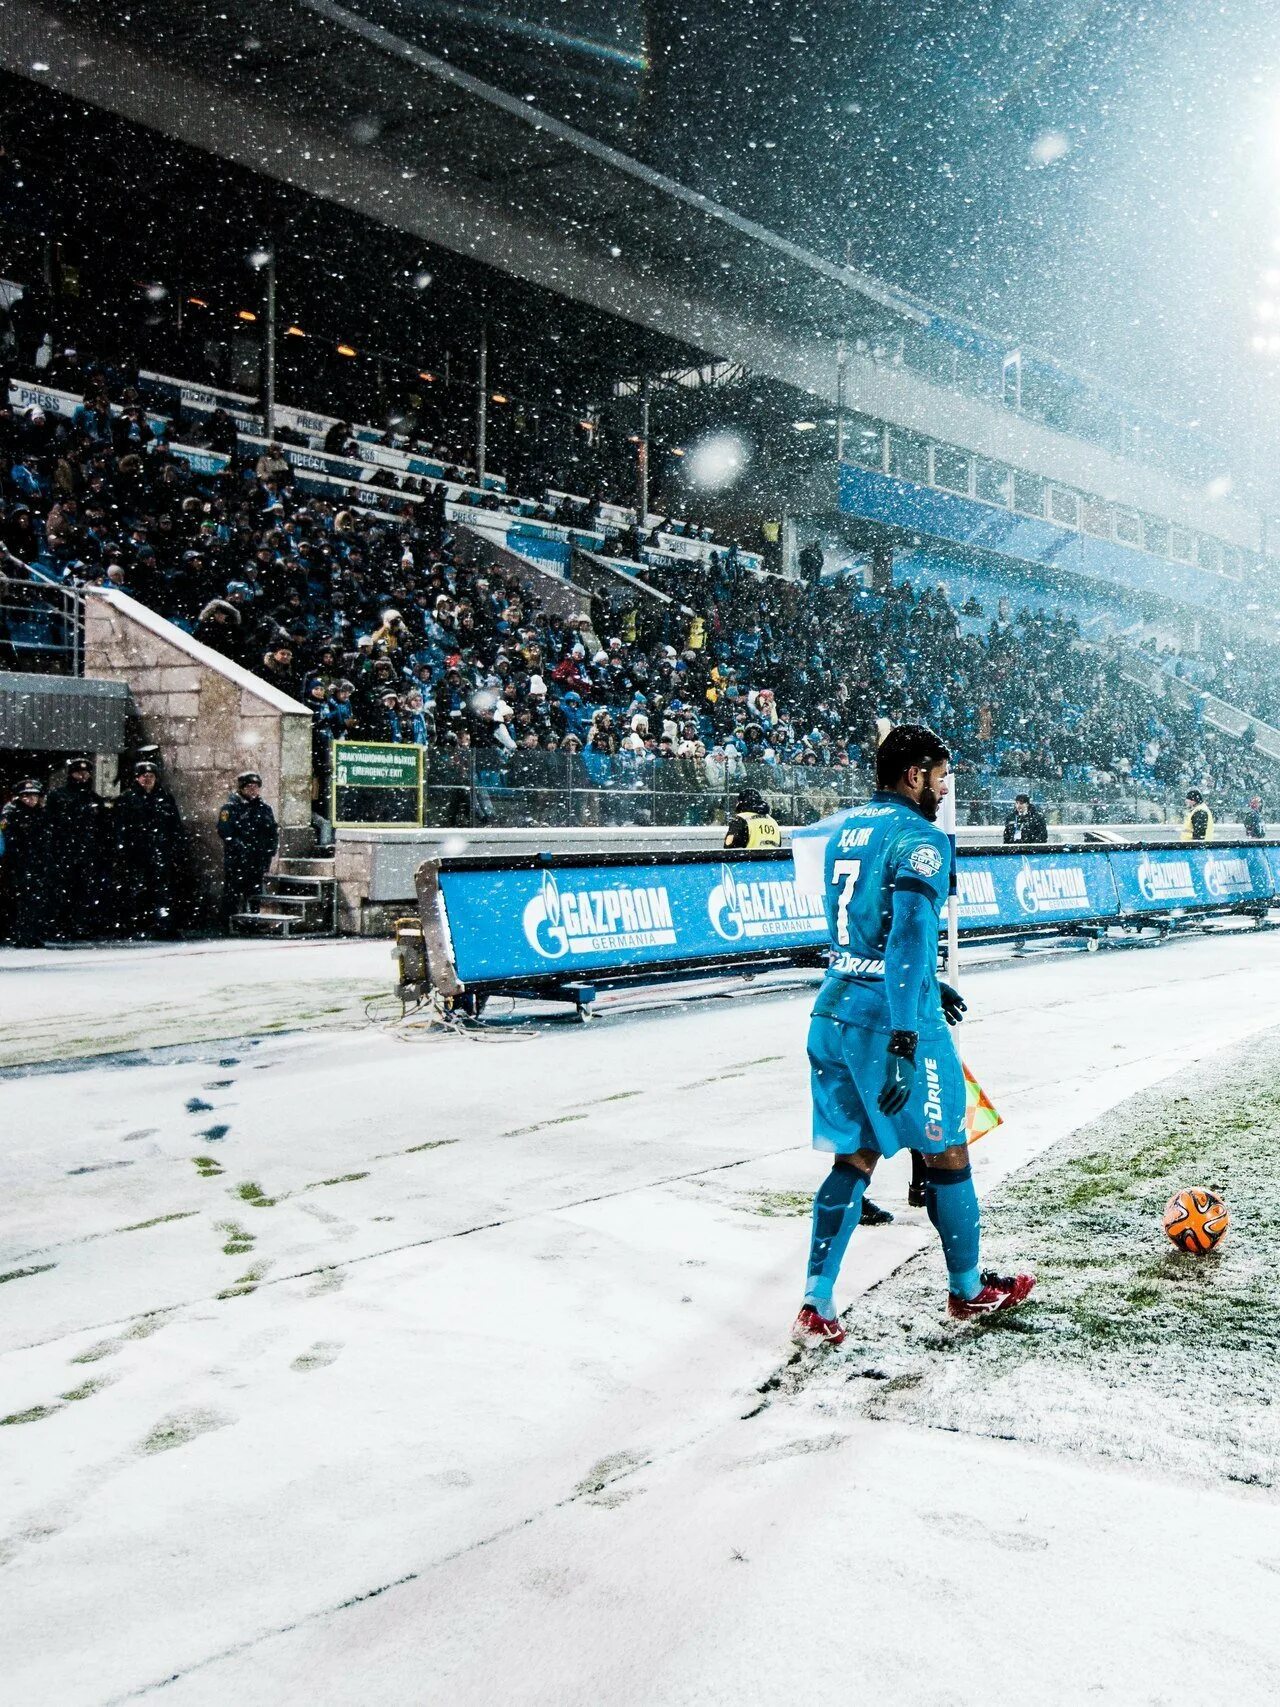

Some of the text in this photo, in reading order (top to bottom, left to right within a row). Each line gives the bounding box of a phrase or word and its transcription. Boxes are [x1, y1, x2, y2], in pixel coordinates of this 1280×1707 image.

[21, 389, 61, 412] PRESS
[296, 416, 324, 432] PRESS
[290, 452, 326, 471] ПРЕССА
[343, 487, 380, 504] ПССА
[452, 510, 477, 525] PRESS
[352, 766, 403, 777] EMERGENCY EXIT
[759, 825, 775, 835] 109
[957, 871, 996, 903] PROM
[1032, 868, 1087, 899] GAZPROM
[831, 859, 861, 945] 7
[560, 886, 674, 937] GAZPROM
[957, 906, 987, 916] ERMANIA
[762, 920, 812, 934] GERMANIA
[592, 933, 657, 950] GERMANIA
